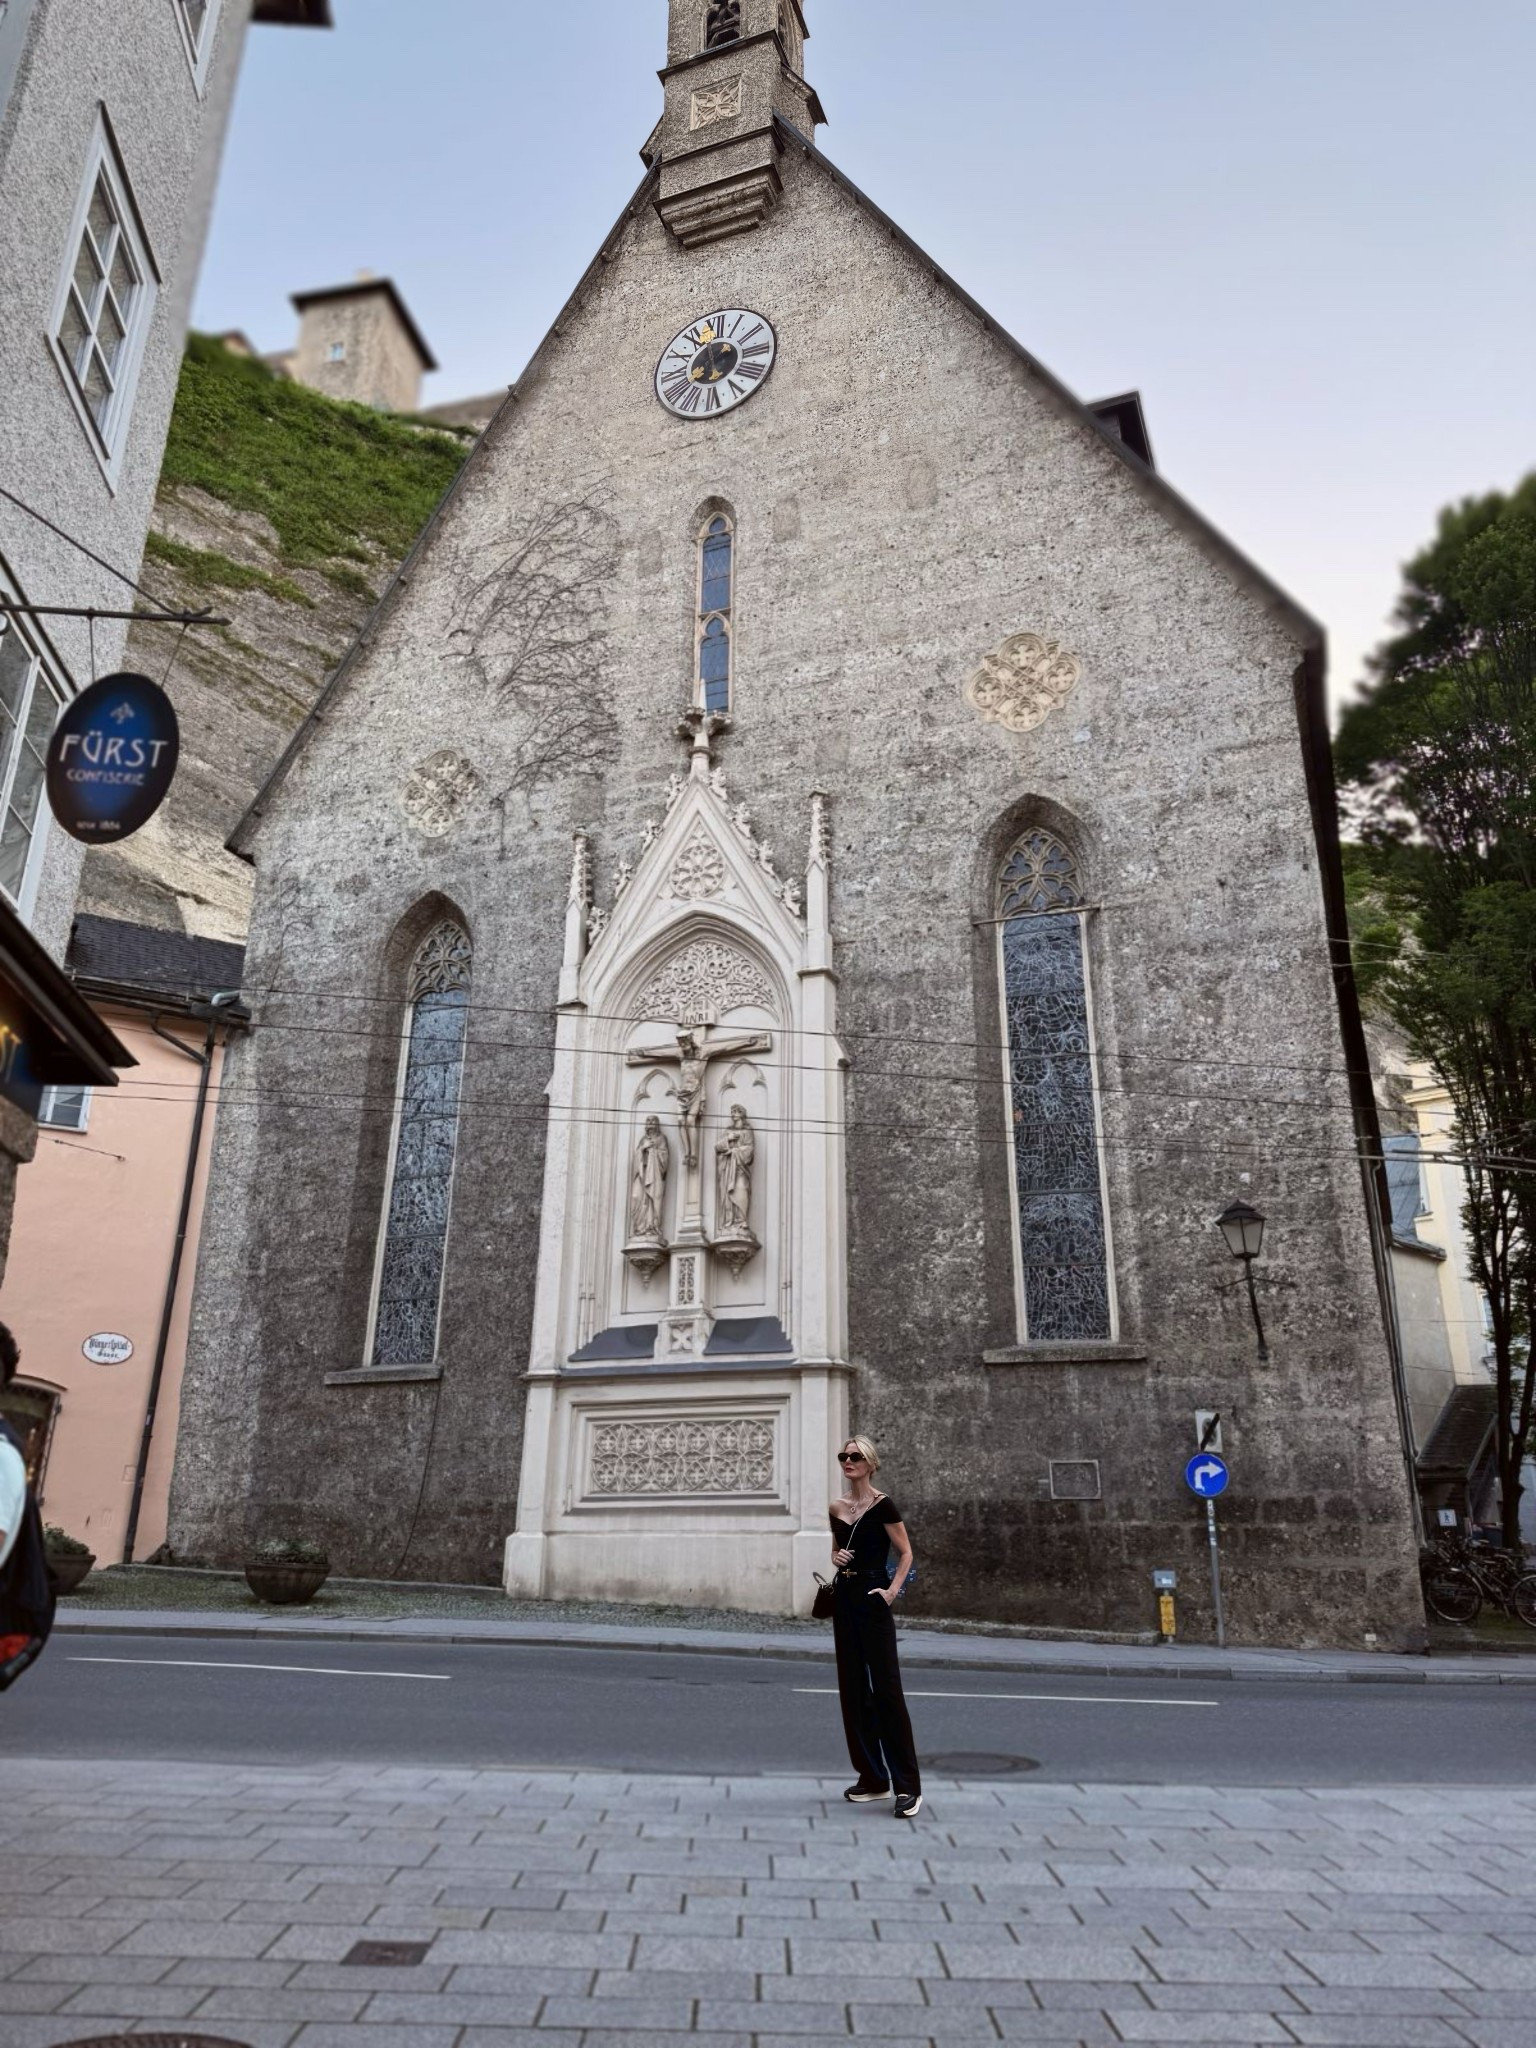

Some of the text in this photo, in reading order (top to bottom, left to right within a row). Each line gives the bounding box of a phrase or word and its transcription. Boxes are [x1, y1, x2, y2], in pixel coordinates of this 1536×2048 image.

[737, 323, 765, 346] II
[666, 348, 694, 363] X
[742, 340, 770, 359] III
[728, 378, 747, 400] V
[59, 731, 169, 768] FÜRST
[66, 769, 145, 786] CONFISERIE
[685, 1011, 709, 1024] INRI
